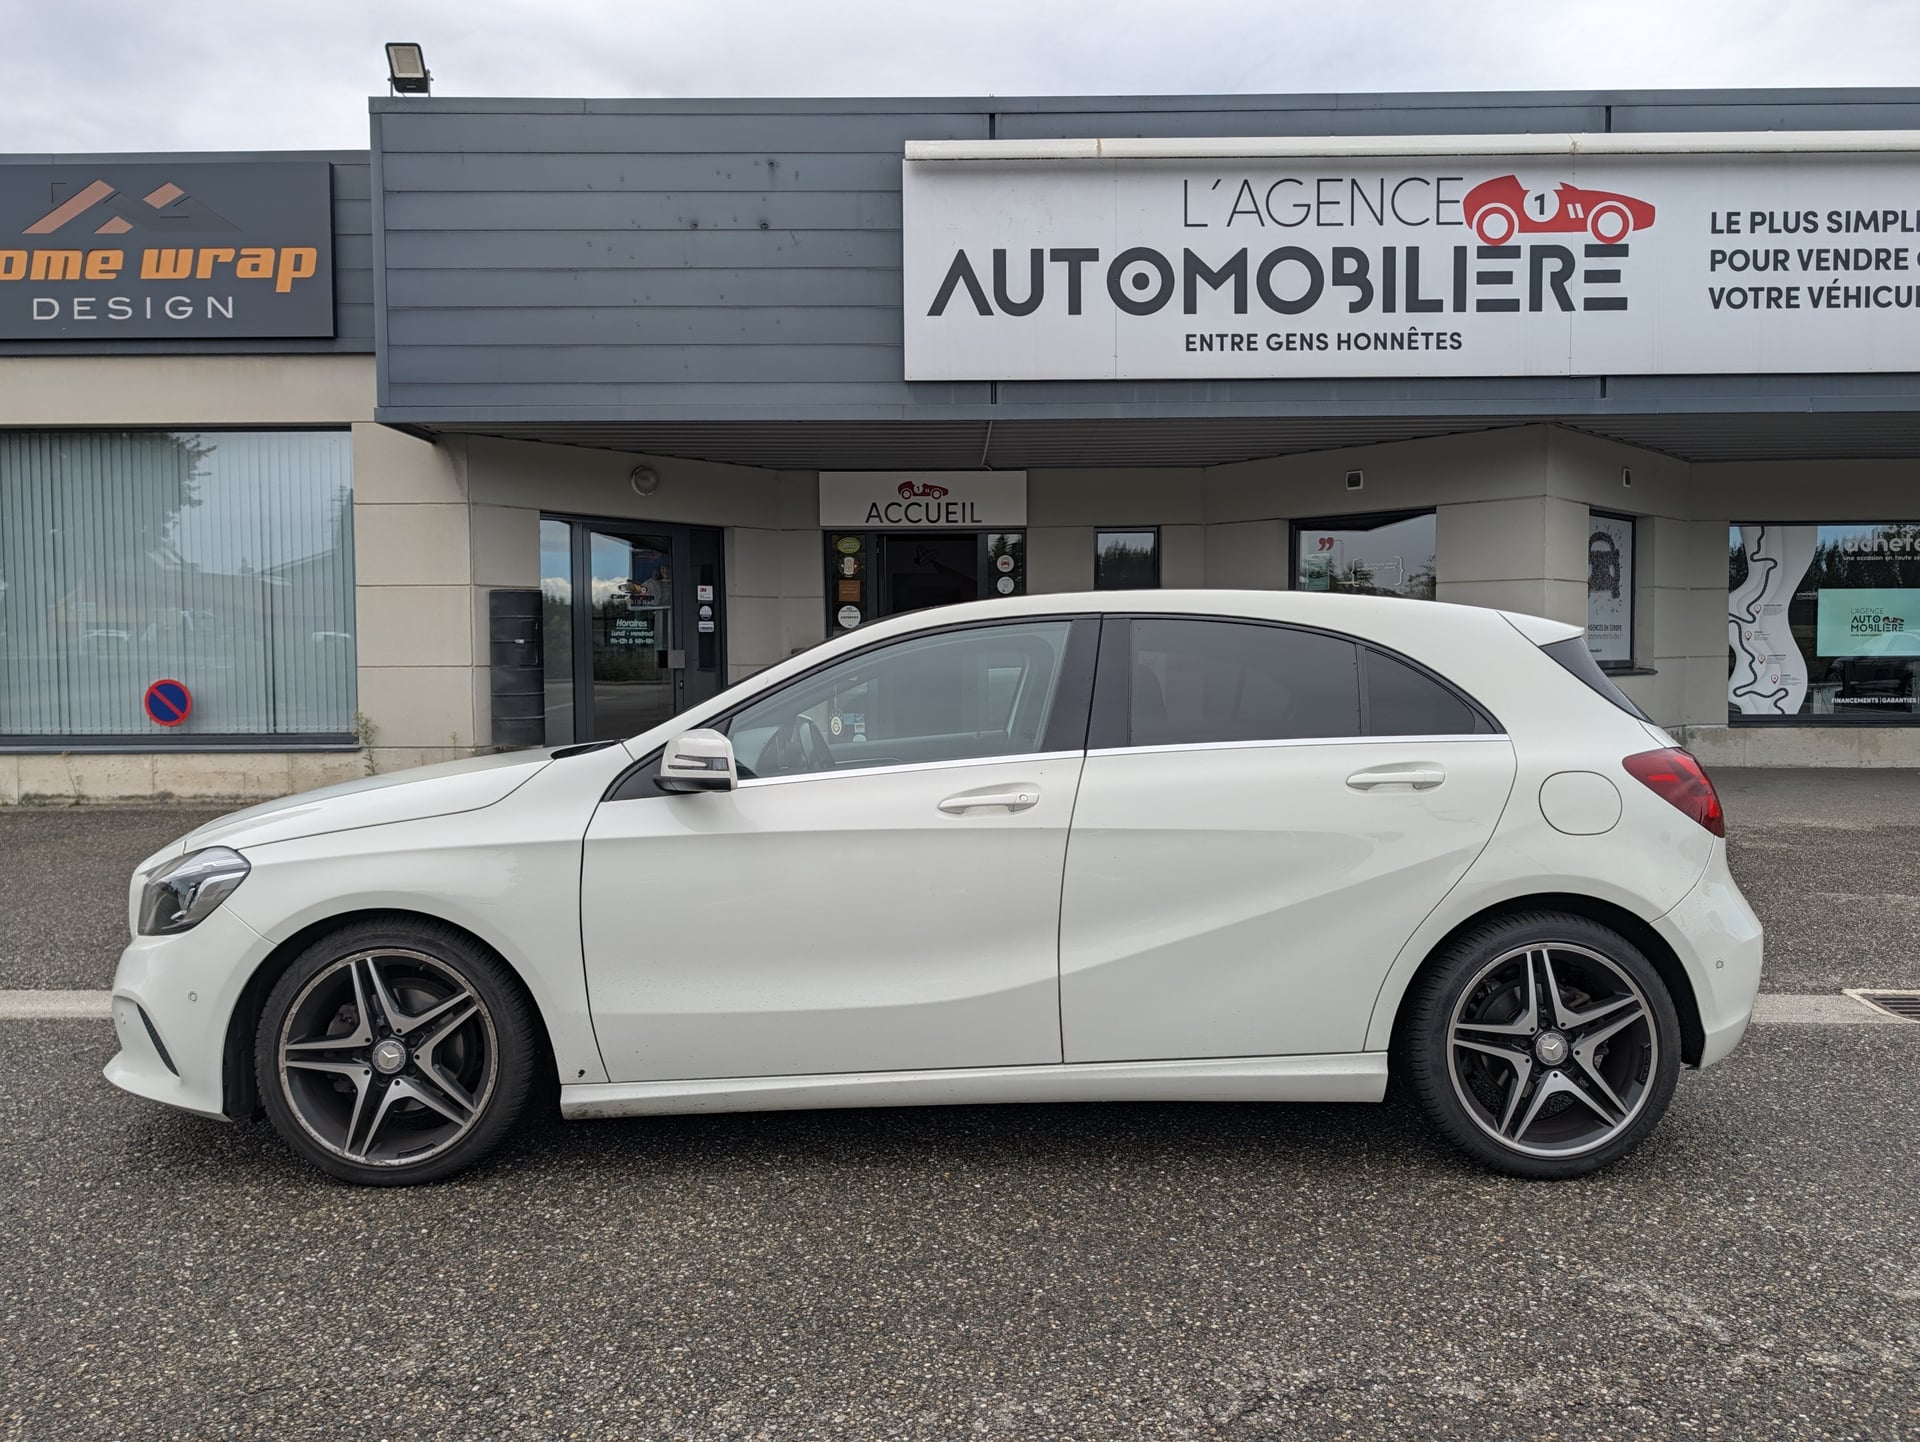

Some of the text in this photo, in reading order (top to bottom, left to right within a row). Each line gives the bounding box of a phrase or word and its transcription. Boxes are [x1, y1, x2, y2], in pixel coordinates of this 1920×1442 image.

[1184, 177, 1464, 228] L'AGENCE
[1533, 193, 1545, 216] 1
[1710, 210, 1920, 234] LE PLUS SIMPL
[140, 247, 318, 293] wrap
[1710, 249, 1789, 272] POUR
[1797, 248, 1909, 271] VENDRE
[32, 295, 234, 321] DESIGN
[1708, 286, 1800, 310] VOTRE
[1185, 326, 1463, 352] ENTRE GENS HONNÊTES
[865, 502, 983, 524] ACCUEIL
[616, 619, 648, 628] Horaires
[1851, 615, 1881, 623] AUTO
